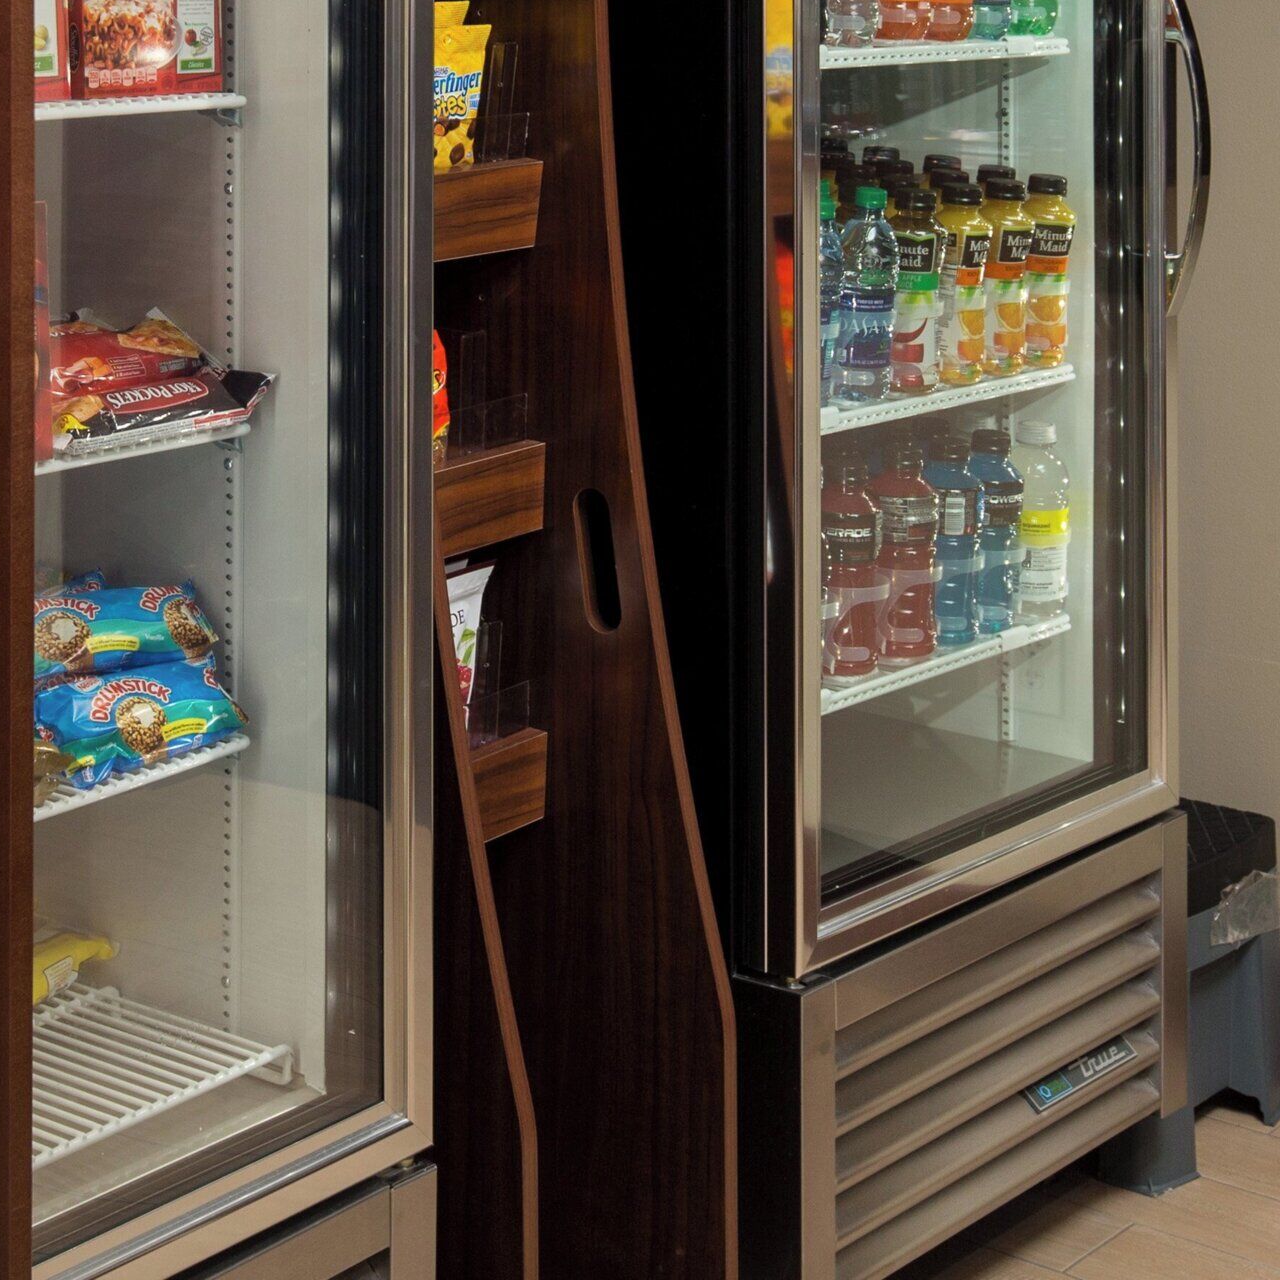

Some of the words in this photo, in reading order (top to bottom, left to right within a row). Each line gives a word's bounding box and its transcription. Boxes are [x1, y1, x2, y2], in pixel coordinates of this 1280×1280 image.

[433, 71, 482, 97] erfinger
[434, 94, 467, 117] ites
[899, 245, 929, 255] nute
[1039, 240, 1068, 253] Maid
[900, 255, 922, 268] aid
[106, 384, 173, 409] POCKETS
[825, 527, 873, 538] ERADE
[89, 677, 171, 723] DRUMSTICK
